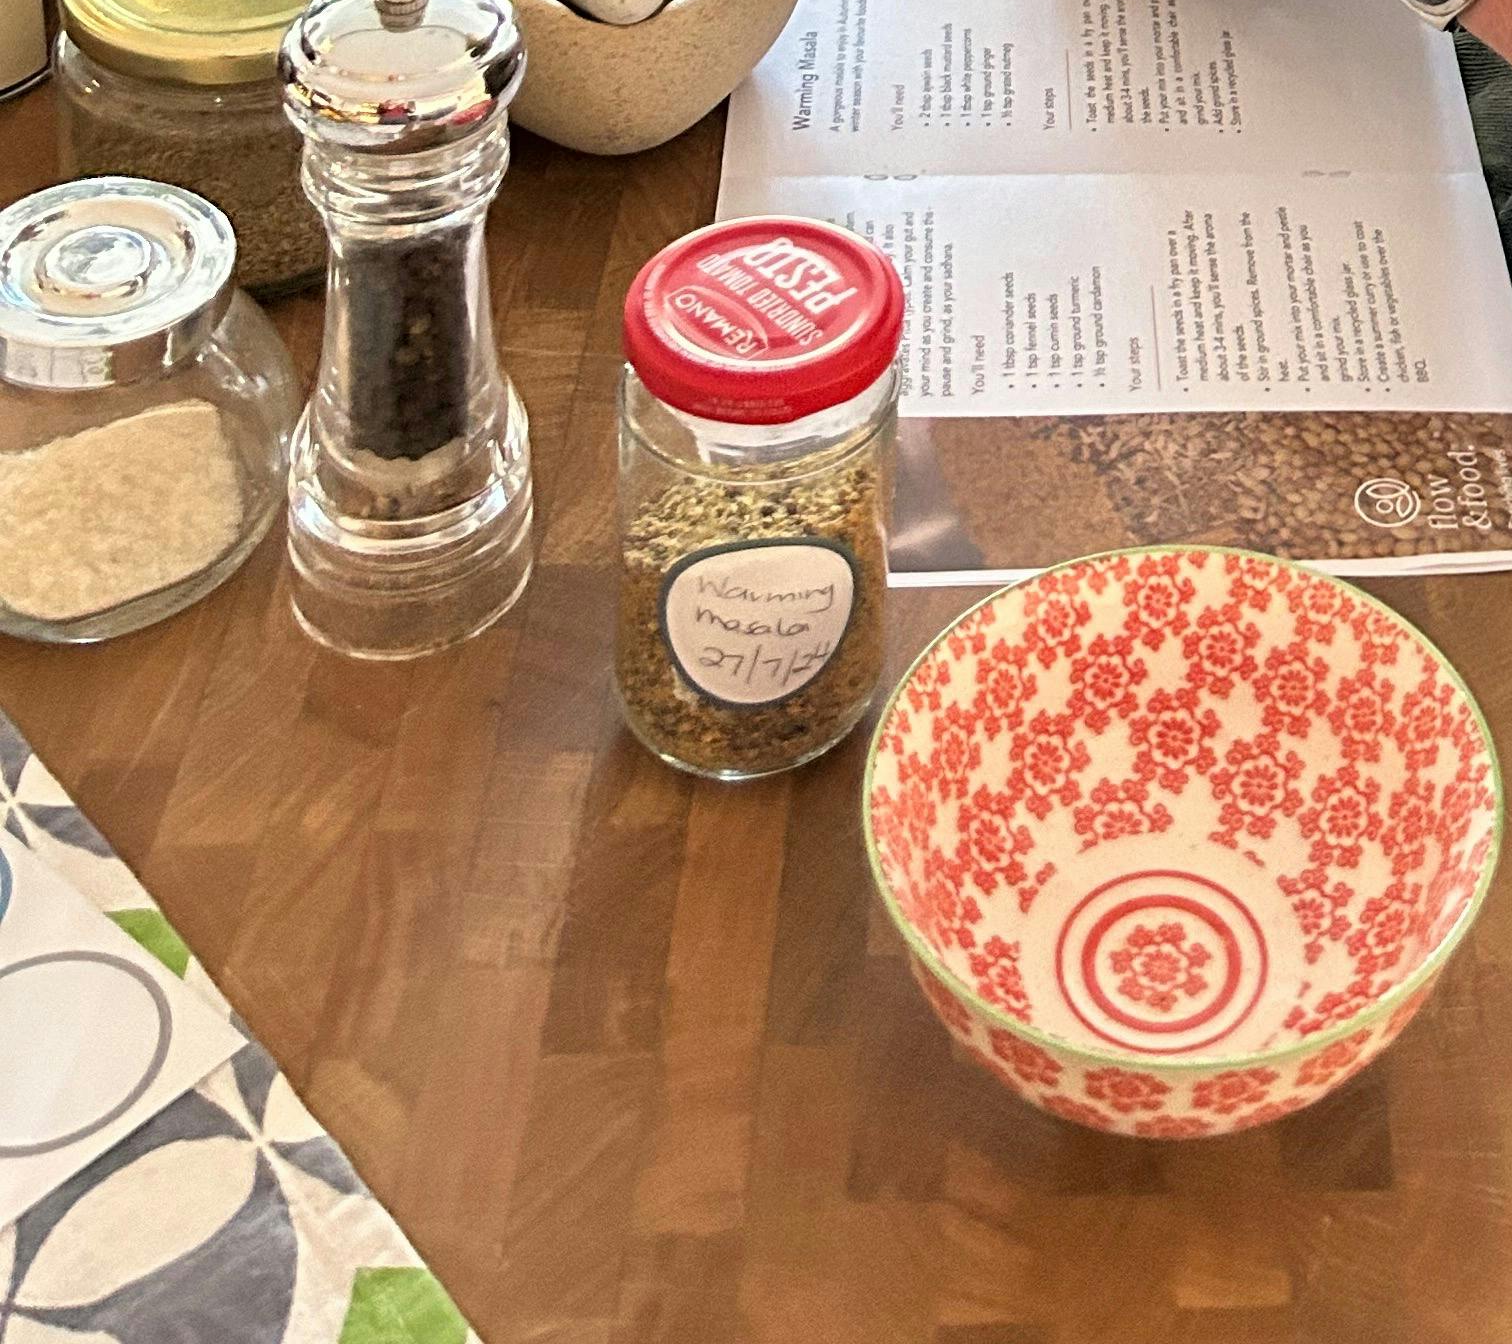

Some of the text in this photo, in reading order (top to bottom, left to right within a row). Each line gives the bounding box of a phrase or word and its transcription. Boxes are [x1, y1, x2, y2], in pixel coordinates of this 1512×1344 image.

[793, 32, 819, 130] Warming Masala
[890, 85, 904, 131] You'll need
[1042, 88, 1056, 130] Your steps
[1182, 211, 1194, 230] After
[1204, 214, 1214, 239] aroma
[1238, 212, 1251, 225] the
[1242, 227, 1253, 247] from
[1278, 233, 1291, 249] and
[1299, 225, 1313, 241] you
[923, 227, 932, 263] consume
[1168, 238, 1178, 256] over
[1204, 242, 1216, 255] the
[1302, 243, 1311, 252] as
[920, 266, 932, 282] and
[1170, 259, 1183, 275] pan
[1208, 259, 1219, 282] sense
[1246, 250, 1258, 285] Remove
[1282, 252, 1296, 282] mortar
[1301, 255, 1314, 275] chair
[696, 253, 755, 299] TOMATO
[743, 237, 857, 316] PESTO
[1001, 272, 1014, 298] seeds
[1168, 278, 1184, 289] fry
[943, 282, 956, 301] your
[1068, 276, 1081, 314] turmeric
[1189, 277, 1203, 299] keep
[1288, 284, 1303, 303] your
[1343, 277, 1360, 298] glass
[920, 286, 931, 313] create
[943, 304, 952, 314] as
[1024, 293, 1036, 319] seeds
[1046, 293, 1059, 320] seeds
[1304, 278, 1322, 331] comfortable
[747, 288, 823, 346] SUNDRIED
[1190, 302, 1202, 319] and
[1289, 306, 1301, 322] into
[1345, 301, 1364, 337] recycled
[674, 294, 759, 354] REMANO
[922, 316, 935, 333] you
[940, 317, 956, 344] grind,
[1002, 301, 1014, 345] coriander
[1091, 313, 1108, 347] ground
[1171, 310, 1184, 336] seeds
[1191, 322, 1204, 340] heat
[1292, 326, 1304, 341] mix
[922, 335, 931, 345] as
[1024, 322, 1037, 351] fennel
[1047, 323, 1060, 351] cumin
[1069, 317, 1087, 351] ground
[1213, 337, 1226, 352] 3-4
[1251, 320, 1270, 353] ground
[940, 347, 951, 364] and
[1173, 339, 1185, 353] the
[1297, 344, 1311, 364] your
[1313, 341, 1325, 349] in
[1335, 336, 1350, 355] your
[1354, 347, 1366, 355] in
[918, 348, 930, 371] mind
[971, 335, 985, 394] You'll need
[1002, 347, 1017, 369] tbsp
[1025, 354, 1040, 368] tsp
[1048, 353, 1063, 368] tsp
[1071, 353, 1087, 368] tsp
[1093, 350, 1108, 364] tsp
[1127, 337, 1143, 392] Your steps
[1195, 344, 1208, 381] medium
[1235, 355, 1248, 369] the
[1256, 355, 1268, 363] in
[1314, 352, 1327, 361] sit
[1174, 356, 1187, 381] Toast
[1215, 355, 1229, 381] about
[1237, 372, 1249, 381] of
[1258, 366, 1270, 381] Stir
[1297, 366, 1310, 381] Put
[1316, 365, 1329, 381] and
[1335, 358, 1354, 382] grind
[1357, 358, 1370, 381] Store
[921, 375, 934, 396] your
[942, 367, 955, 396] pause
[1427, 474, 1458, 530] flow
